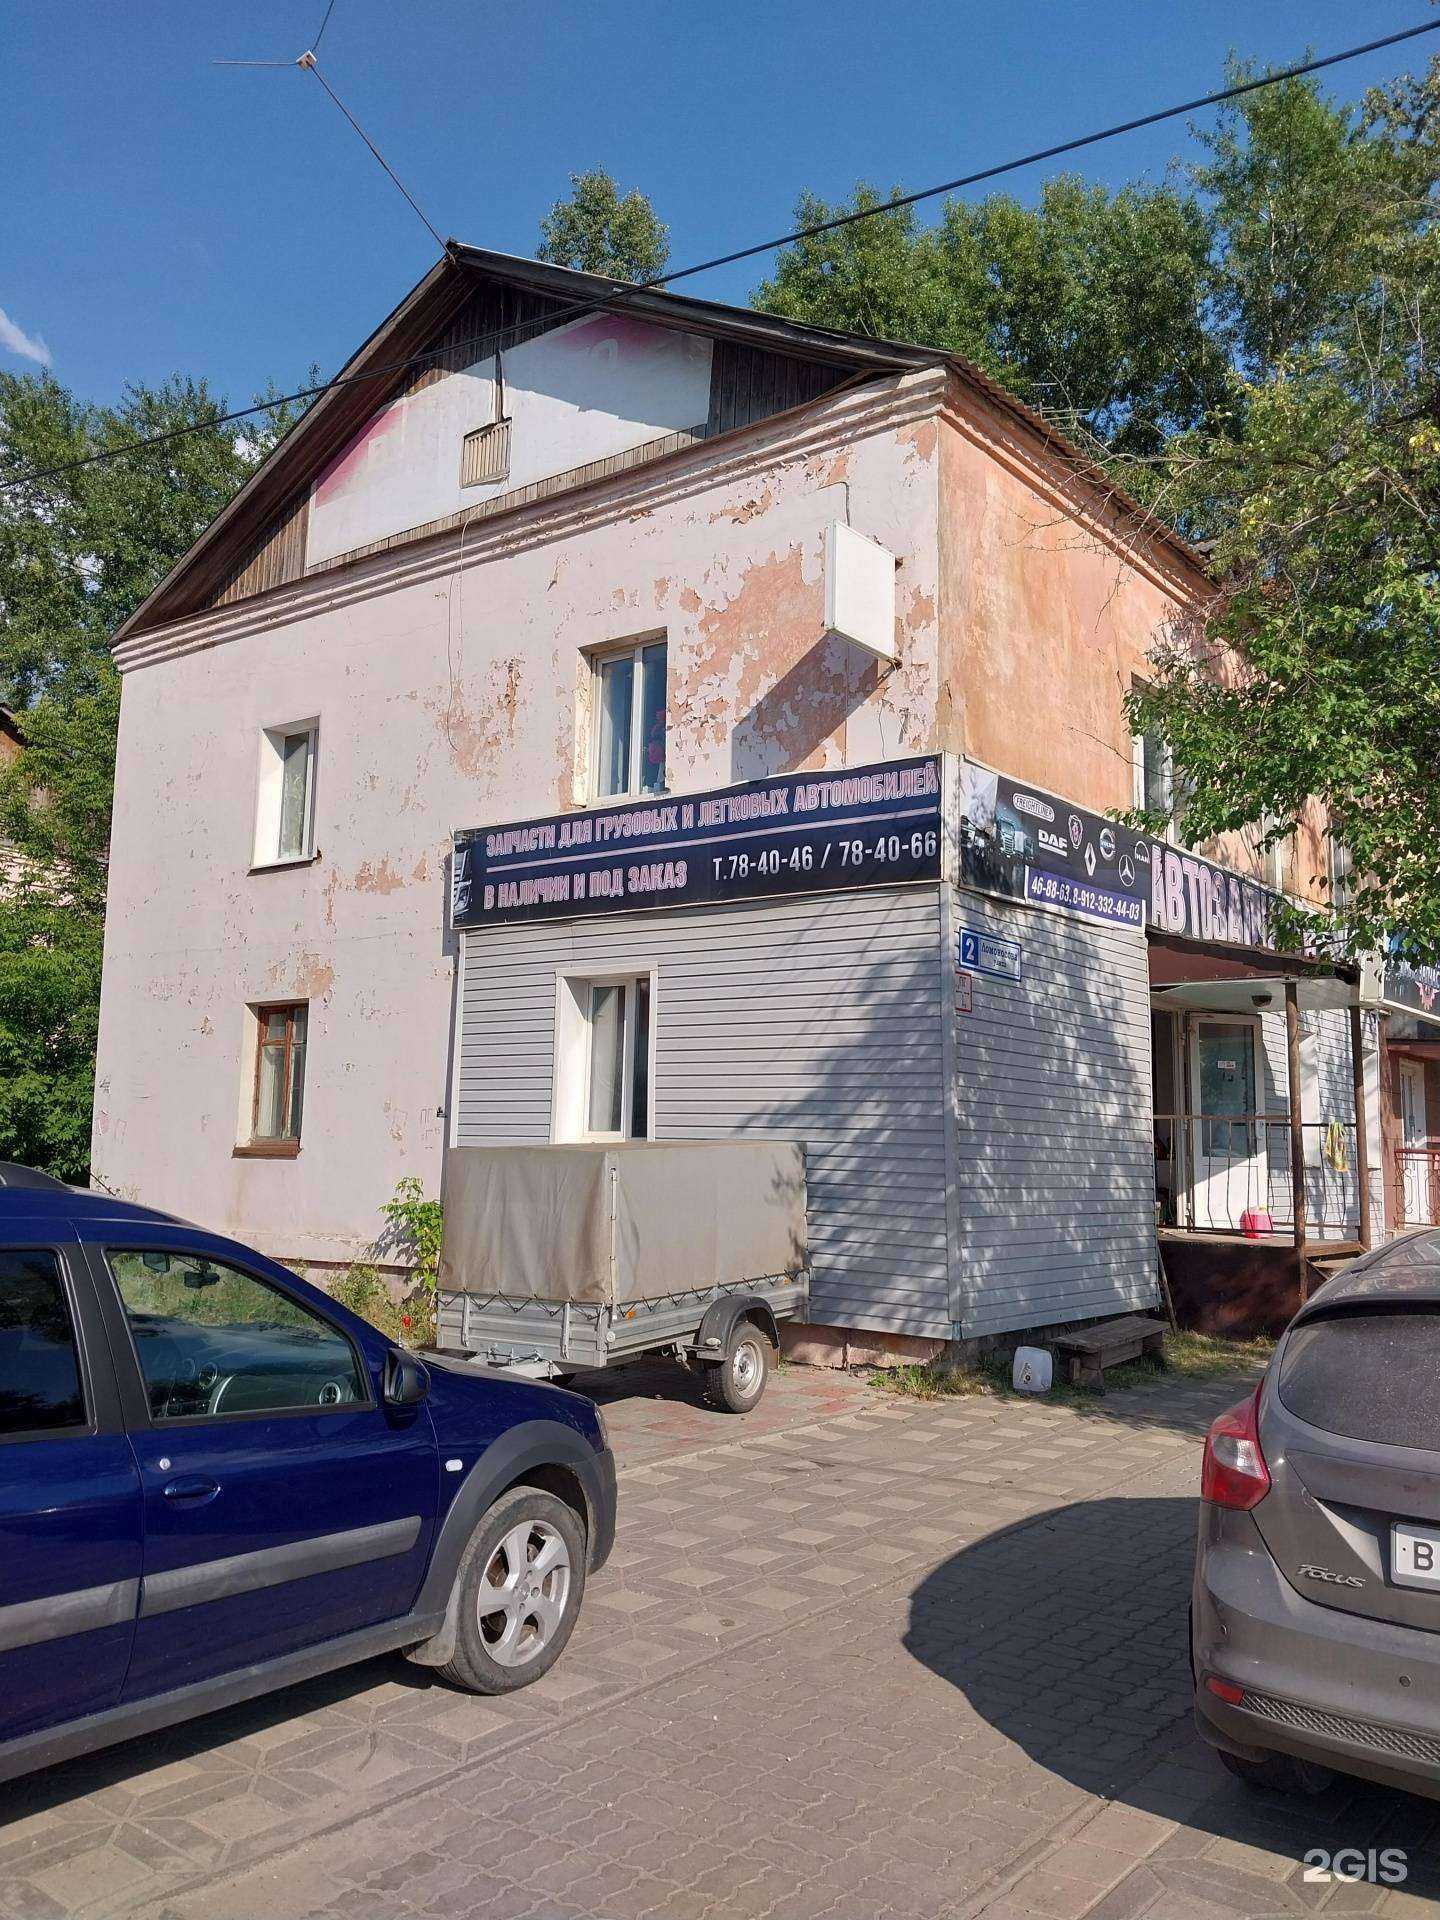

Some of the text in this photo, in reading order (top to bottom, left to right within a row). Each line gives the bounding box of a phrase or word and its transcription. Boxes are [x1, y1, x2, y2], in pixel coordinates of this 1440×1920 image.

[486, 762, 938, 857] ЗАПЧАСТИ ДЛЯ ГРУЗОВЫХ И ЛЕГКОВЫХ АВТОМОБИЛЕЙ
[838, 831, 937, 867] 78-40-66
[1038, 829, 1067, 849] DAF
[1135, 853, 1150, 864] MAN
[484, 861, 688, 909] В НАЛИЧИИ И ПОД ЗАКАЗ
[966, 937, 975, 960] 2
